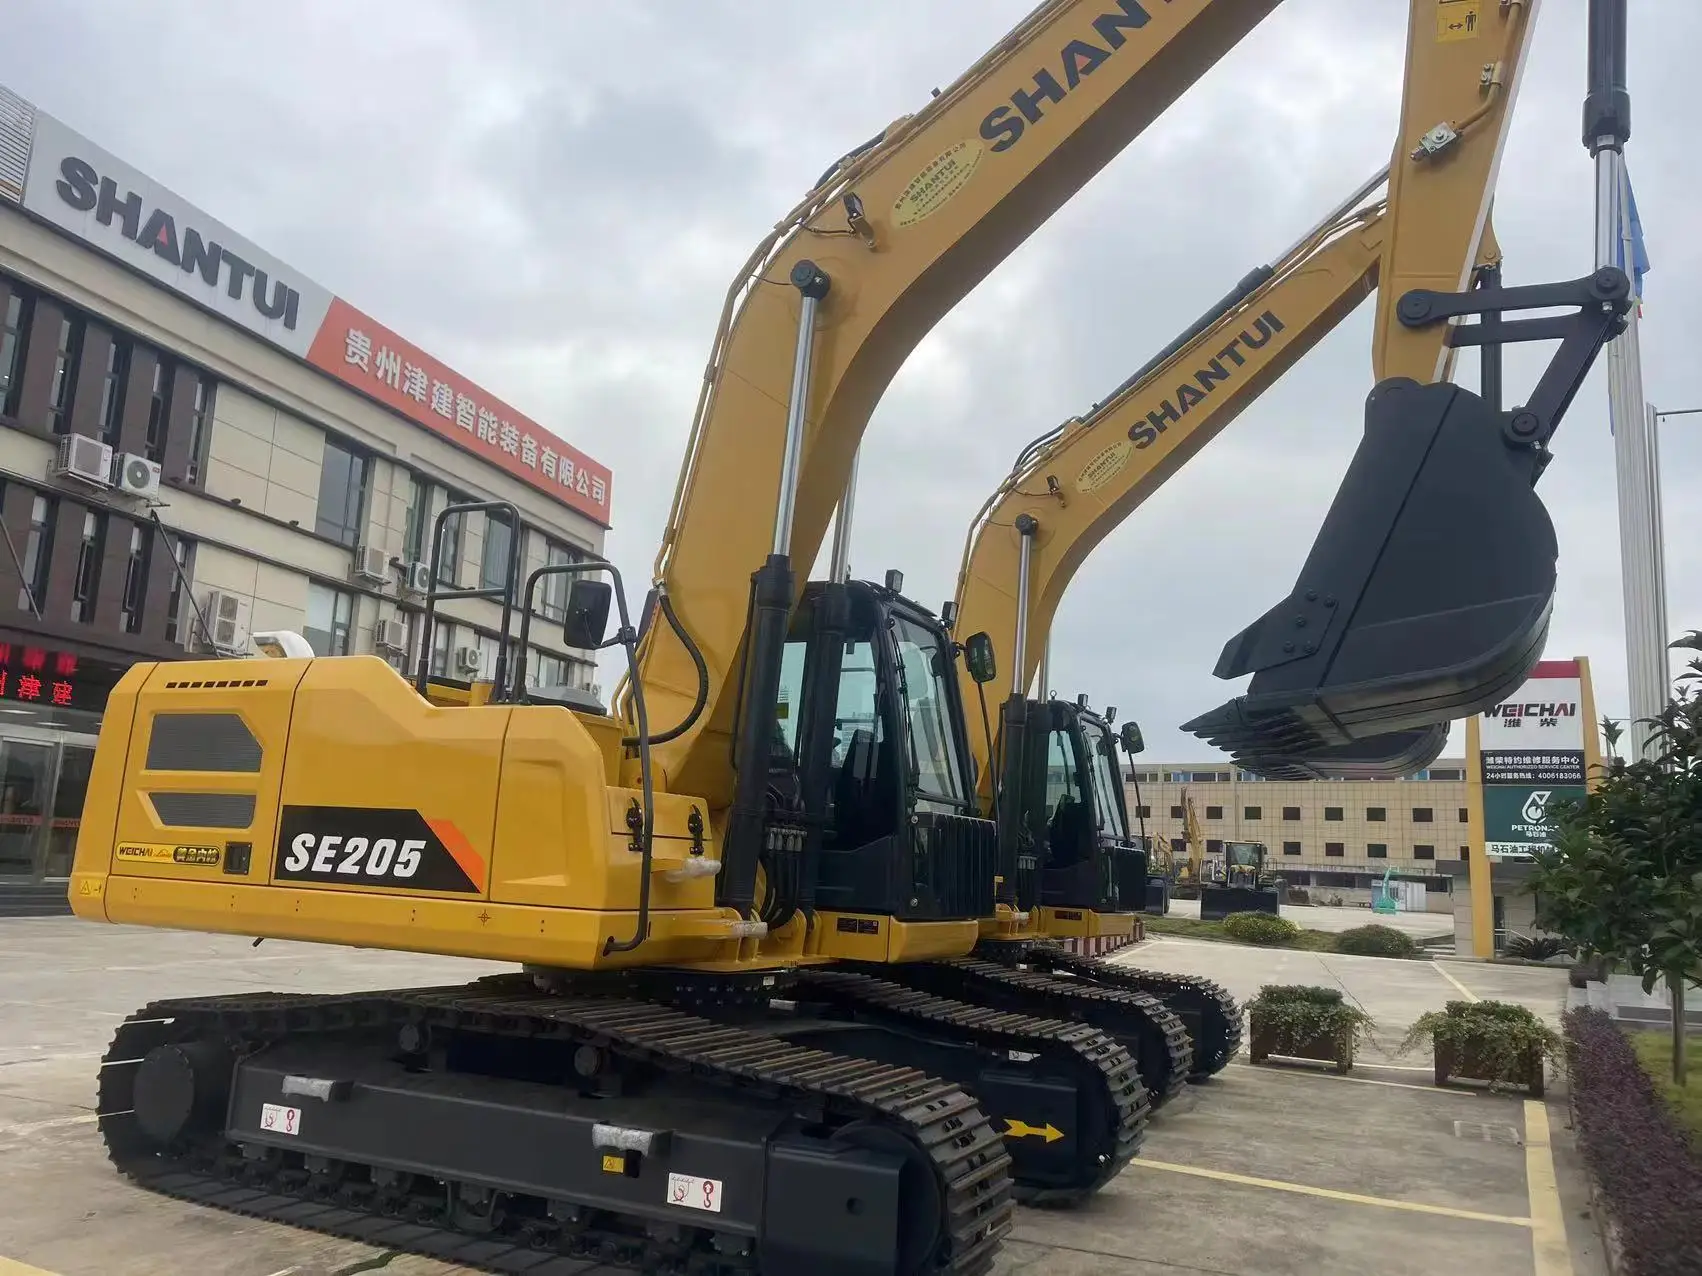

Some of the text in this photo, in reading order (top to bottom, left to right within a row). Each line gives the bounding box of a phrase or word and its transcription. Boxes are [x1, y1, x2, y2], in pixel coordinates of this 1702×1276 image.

[979, 0, 1174, 153] SHAN
[910, 158, 957, 203] SHANTUI
[56, 156, 300, 331] SHANTUI
[344, 328, 607, 507] 贵州津建智能装备有限公司
[1127, 310, 1286, 449] SHANTUI
[1484, 703, 1577, 718] WEICHAI
[119, 846, 154, 857] WEICHAI
[285, 832, 427, 878] SE205
